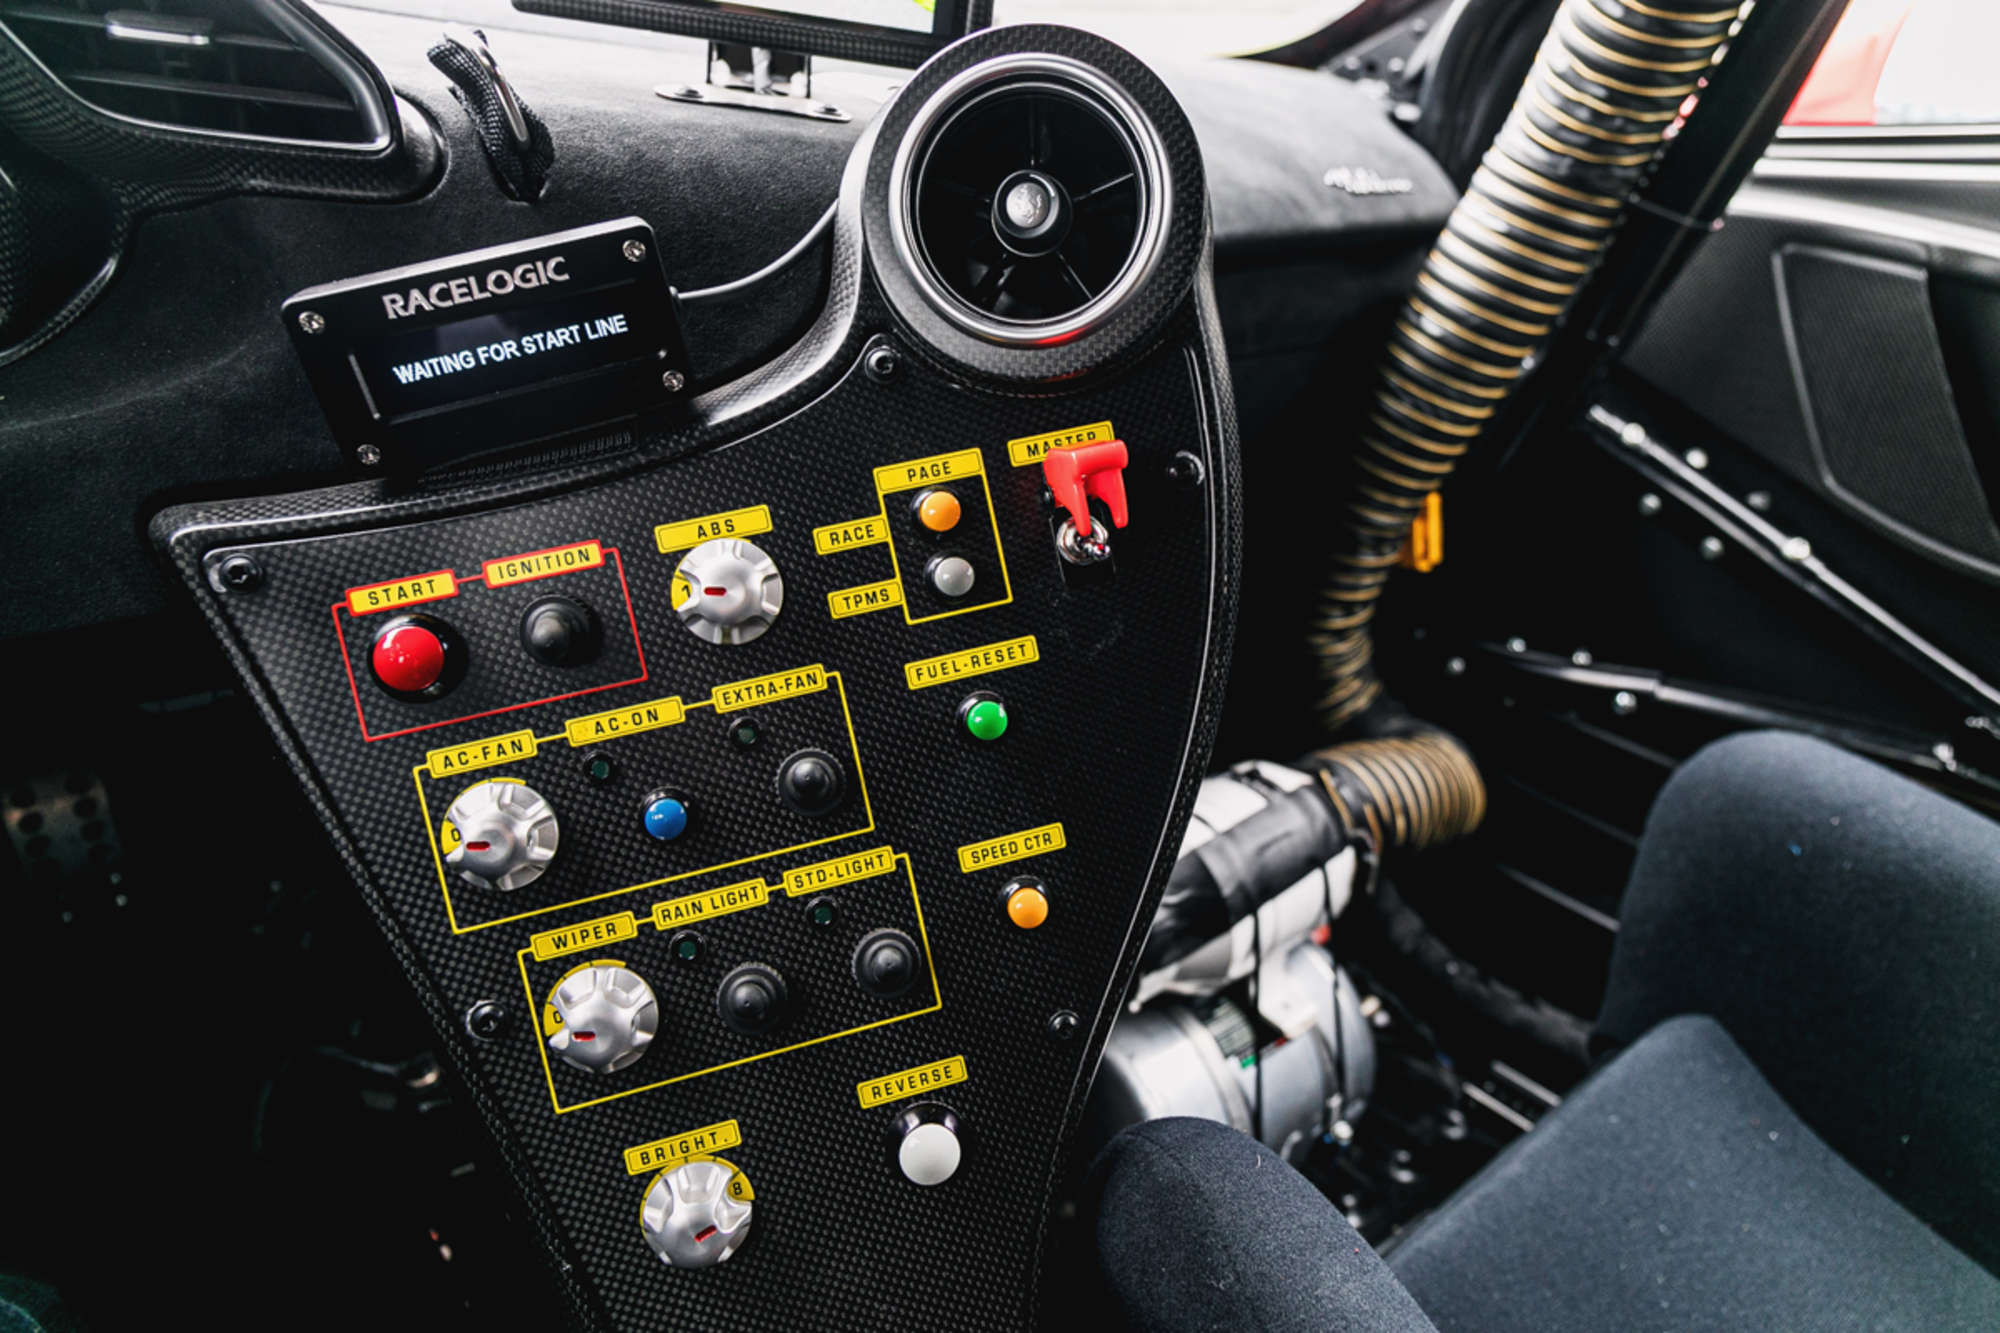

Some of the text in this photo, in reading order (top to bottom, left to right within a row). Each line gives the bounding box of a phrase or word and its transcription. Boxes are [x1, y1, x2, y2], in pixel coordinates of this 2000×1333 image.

[382, 256, 570, 320] RACELOGIC
[393, 314, 629, 385] WAITING FOR START LINE
[906, 461, 953, 482] PAGE
[696, 518, 735, 540] ABS
[829, 523, 875, 546] RACE
[497, 547, 591, 579] IGNITION
[367, 579, 436, 607] START
[843, 588, 891, 611] TPMS
[915, 643, 1028, 682] FUEL-RESET
[721, 671, 820, 706] EXTRA-FAN
[594, 707, 659, 736] AC-ON
[443, 739, 524, 769] AC-FAN
[970, 832, 1053, 866] SPEED CTR
[794, 854, 886, 890] STD-LIGHT
[661, 886, 760, 924] RAIN LIGHT
[551, 921, 618, 951] WIPER
[871, 1064, 953, 1101] REVERSE
[639, 1131, 729, 1166] BRIGHT.
